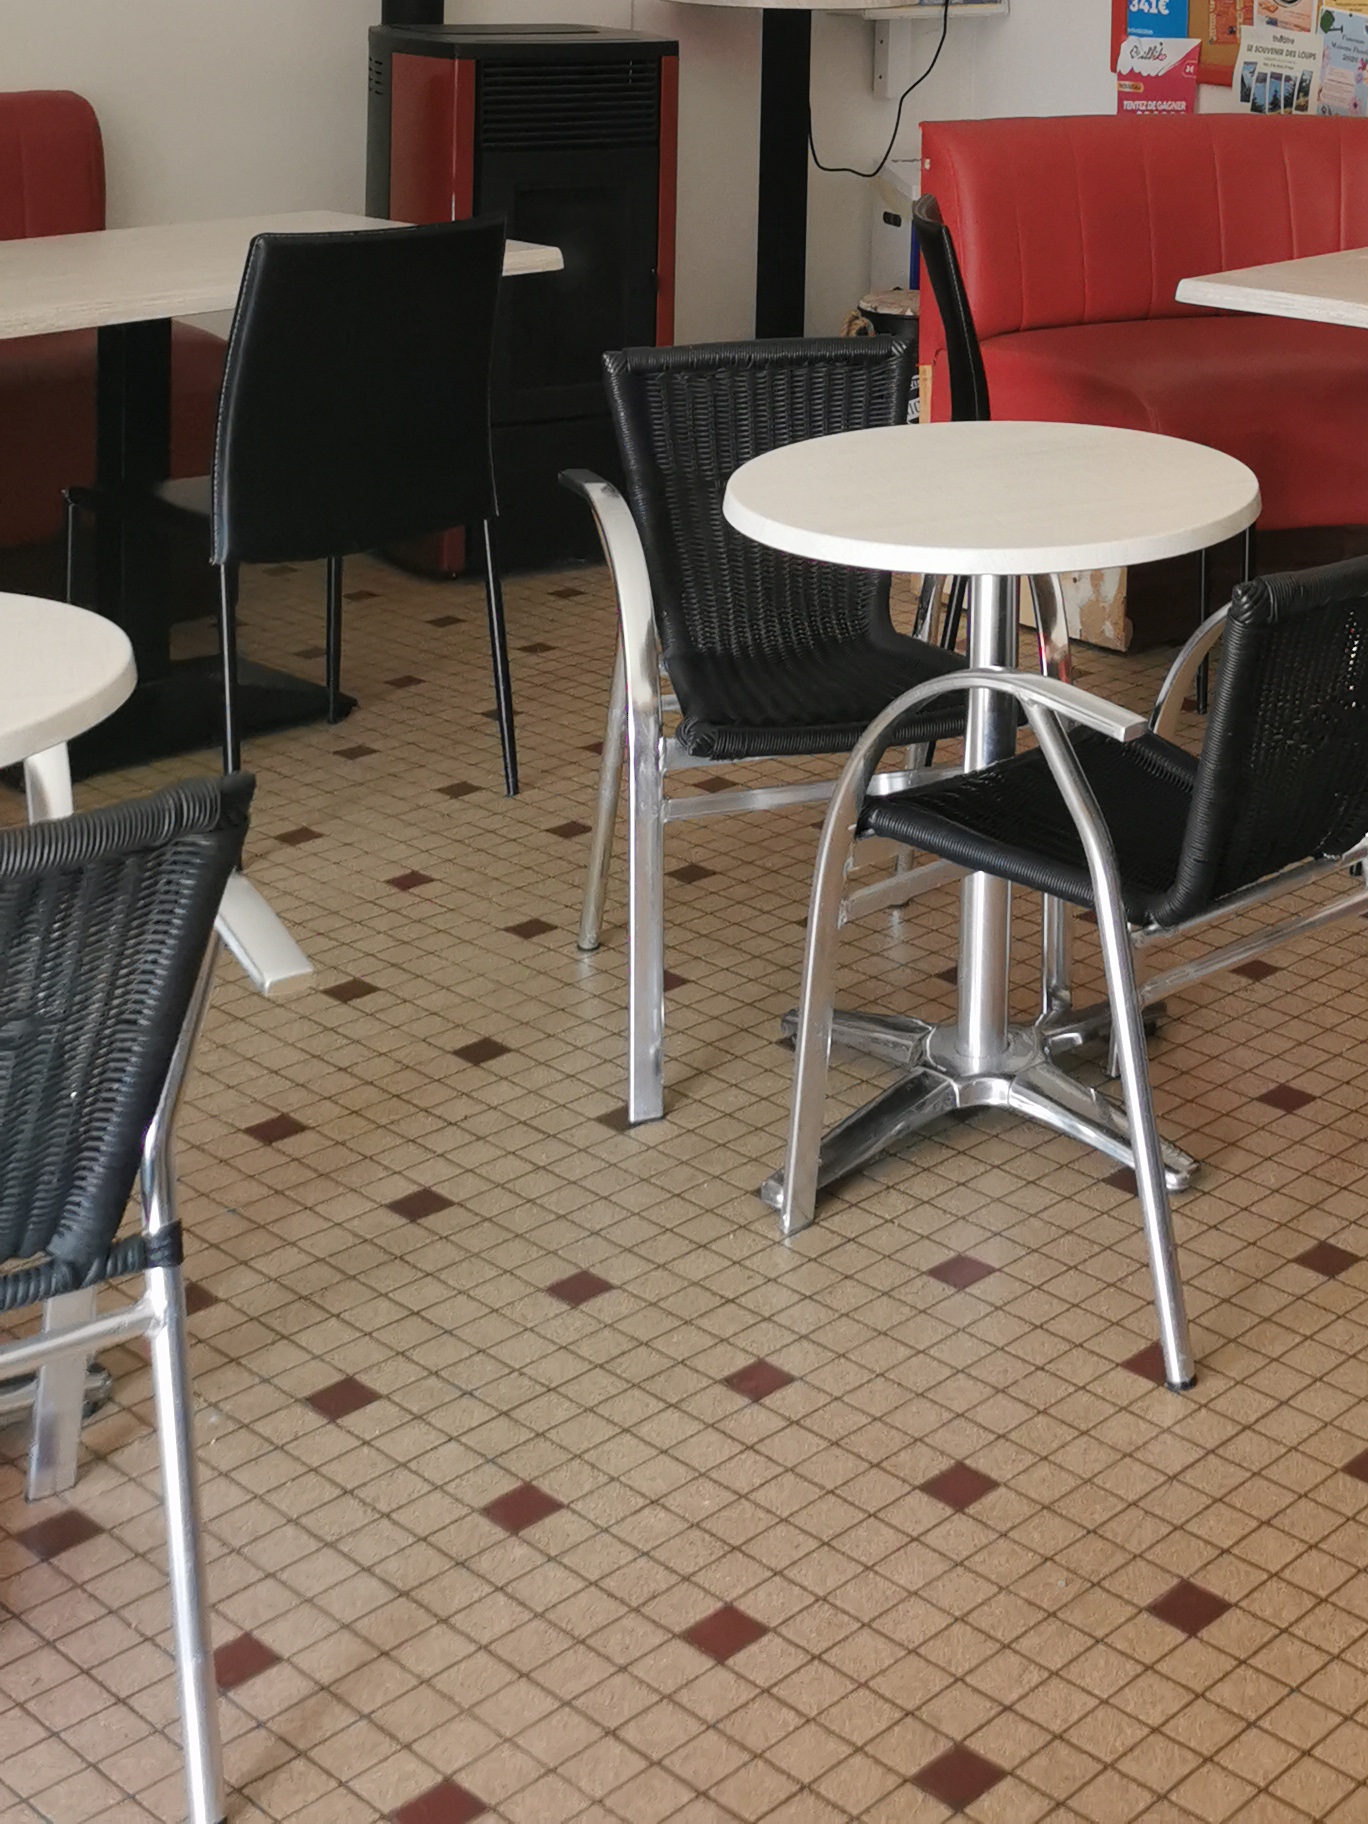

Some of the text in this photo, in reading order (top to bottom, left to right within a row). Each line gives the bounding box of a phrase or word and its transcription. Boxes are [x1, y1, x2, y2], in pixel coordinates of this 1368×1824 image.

[1138, 46, 1167, 61] illiko
[1255, 45, 1284, 56] SOUVENIR
[1285, 49, 1296, 58] DES
[1298, 50, 1316, 61] LOUPS
[1185, 64, 1195, 73] 3€
[1123, 100, 1186, 111] TENTEZ DE GAGNER
